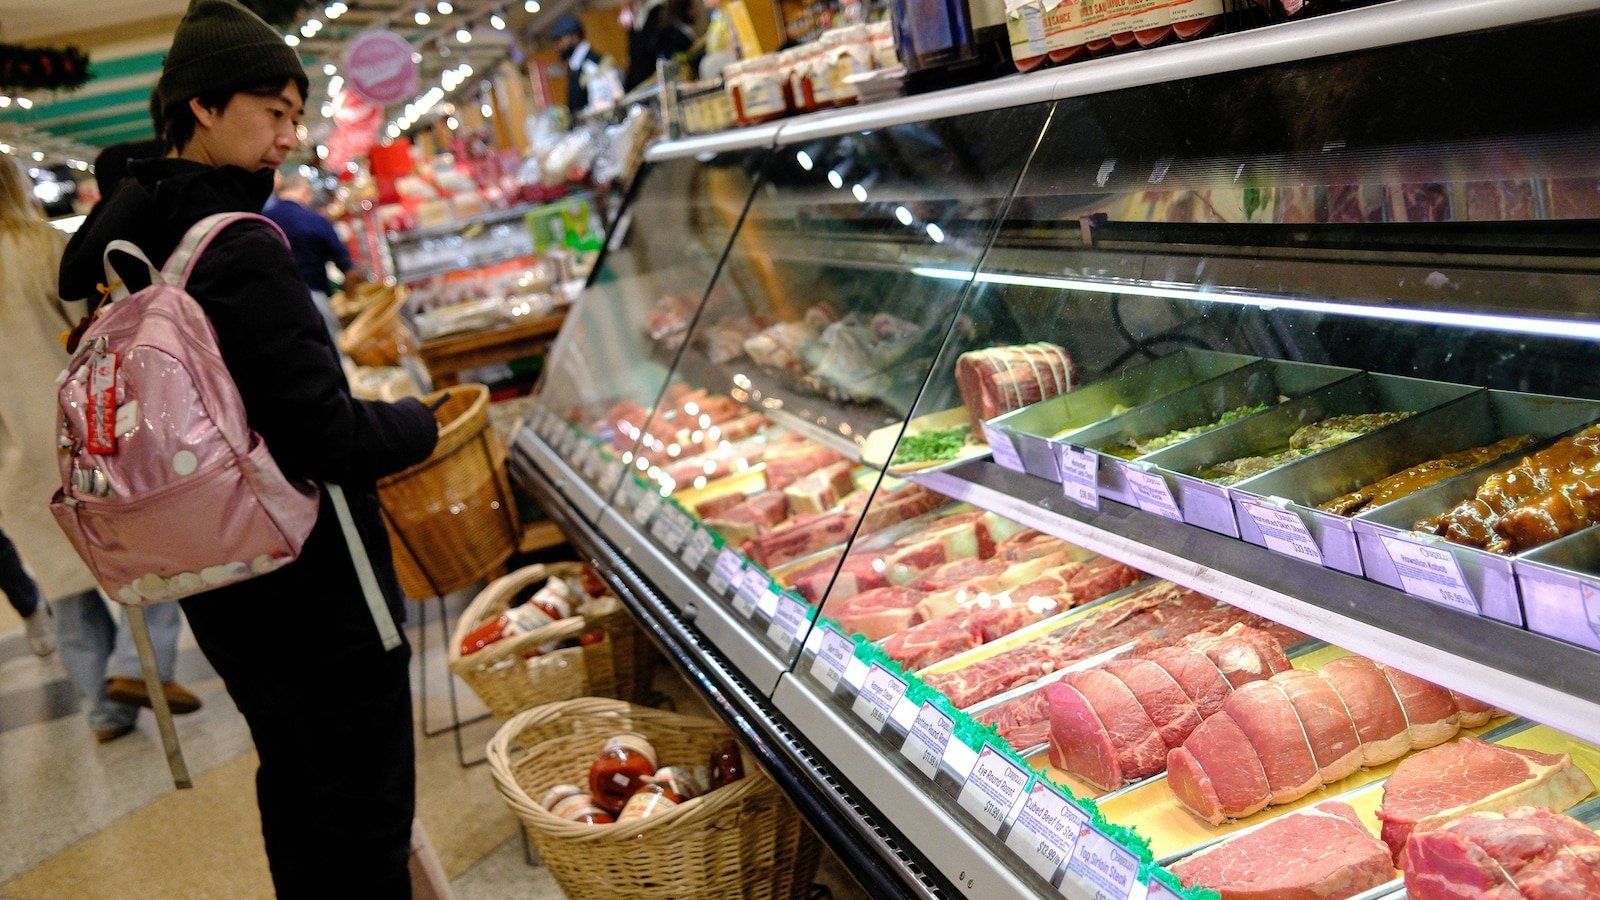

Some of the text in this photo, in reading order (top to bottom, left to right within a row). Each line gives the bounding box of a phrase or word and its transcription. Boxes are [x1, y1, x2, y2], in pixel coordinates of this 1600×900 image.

[1051, 12, 1072, 24] SAUCE
[928, 724, 940, 740] Round
[977, 764, 988, 777] Eye
[986, 770, 1003, 788] Round
[1000, 780, 1015, 798] Roast
[1025, 797, 1045, 817] Cubed
[1042, 809, 1057, 826] Beef
[1054, 819, 1065, 831] for
[1079, 845, 1091, 864] Top
[1090, 852, 1110, 873] Sirloin
[1109, 864, 1128, 887] Steak
